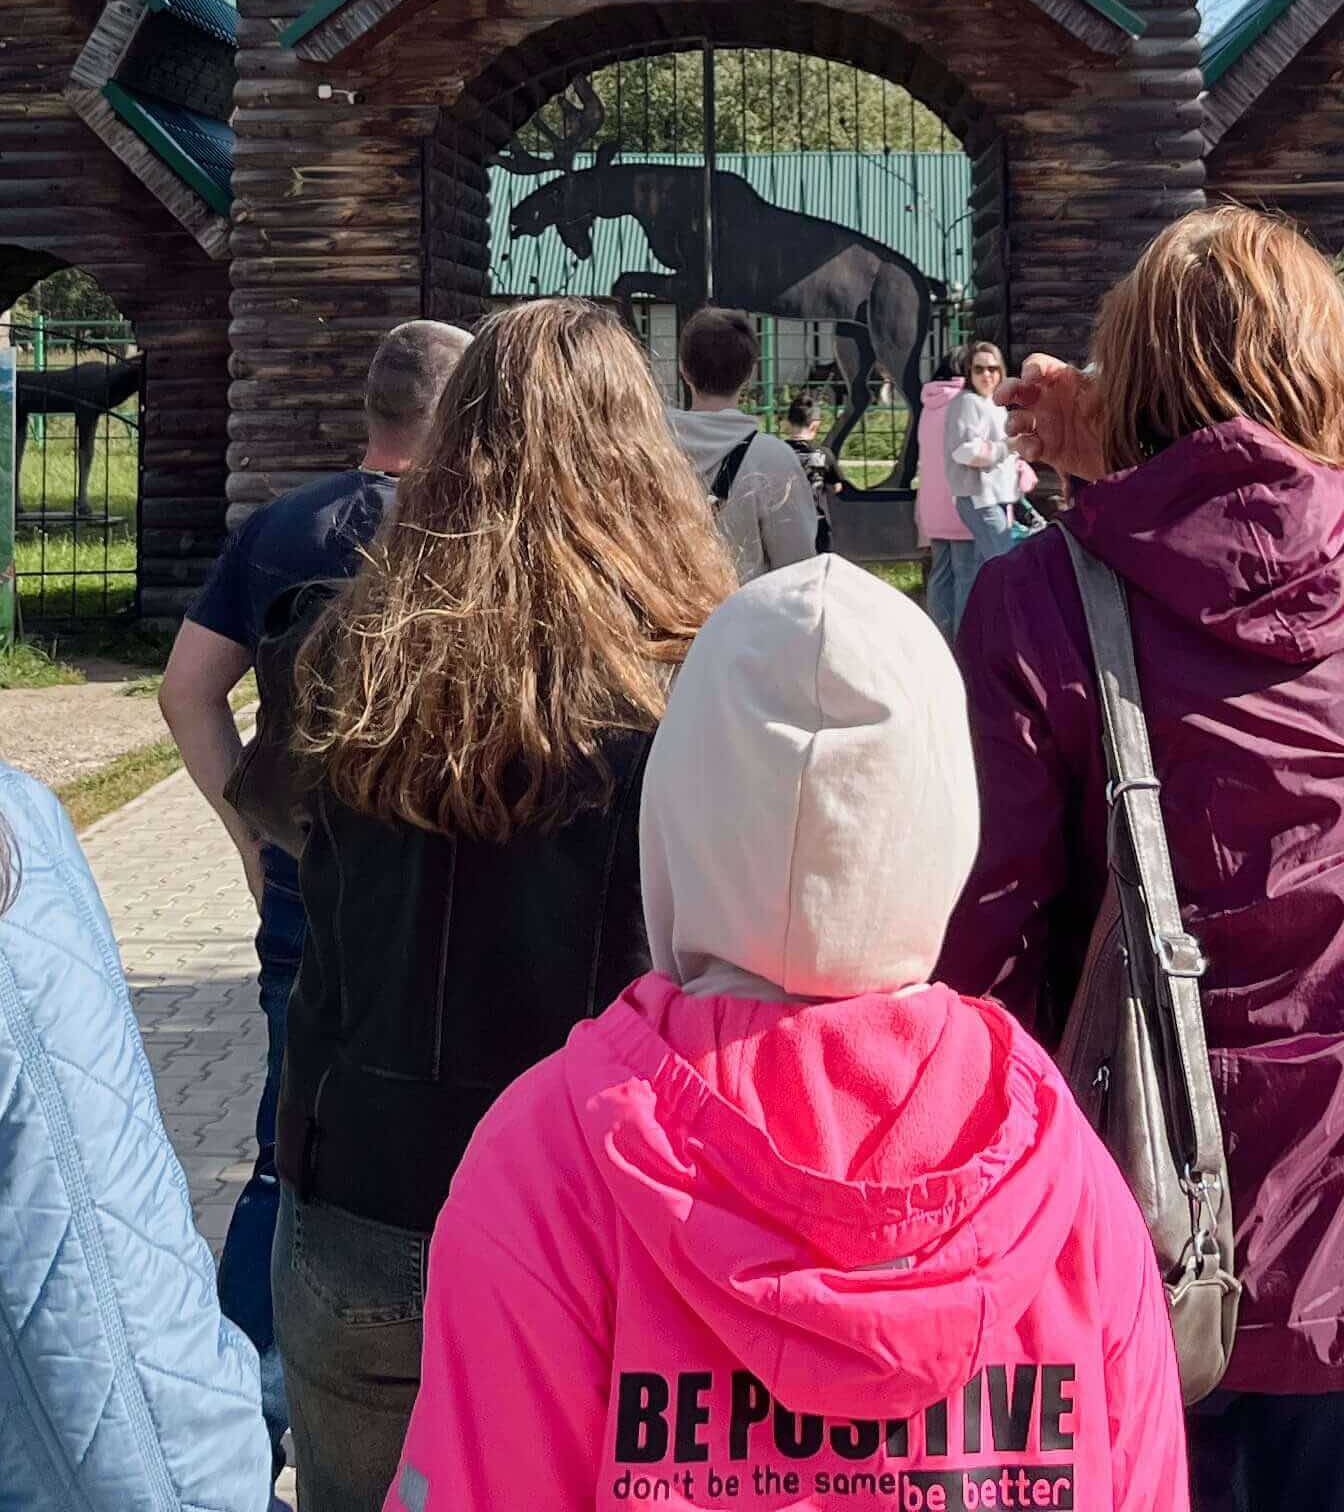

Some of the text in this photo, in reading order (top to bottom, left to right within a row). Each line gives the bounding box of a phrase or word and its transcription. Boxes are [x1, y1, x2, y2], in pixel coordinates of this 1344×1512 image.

[616, 1371, 712, 1463] BE
[613, 1465, 1072, 1512] don't be the same be better
